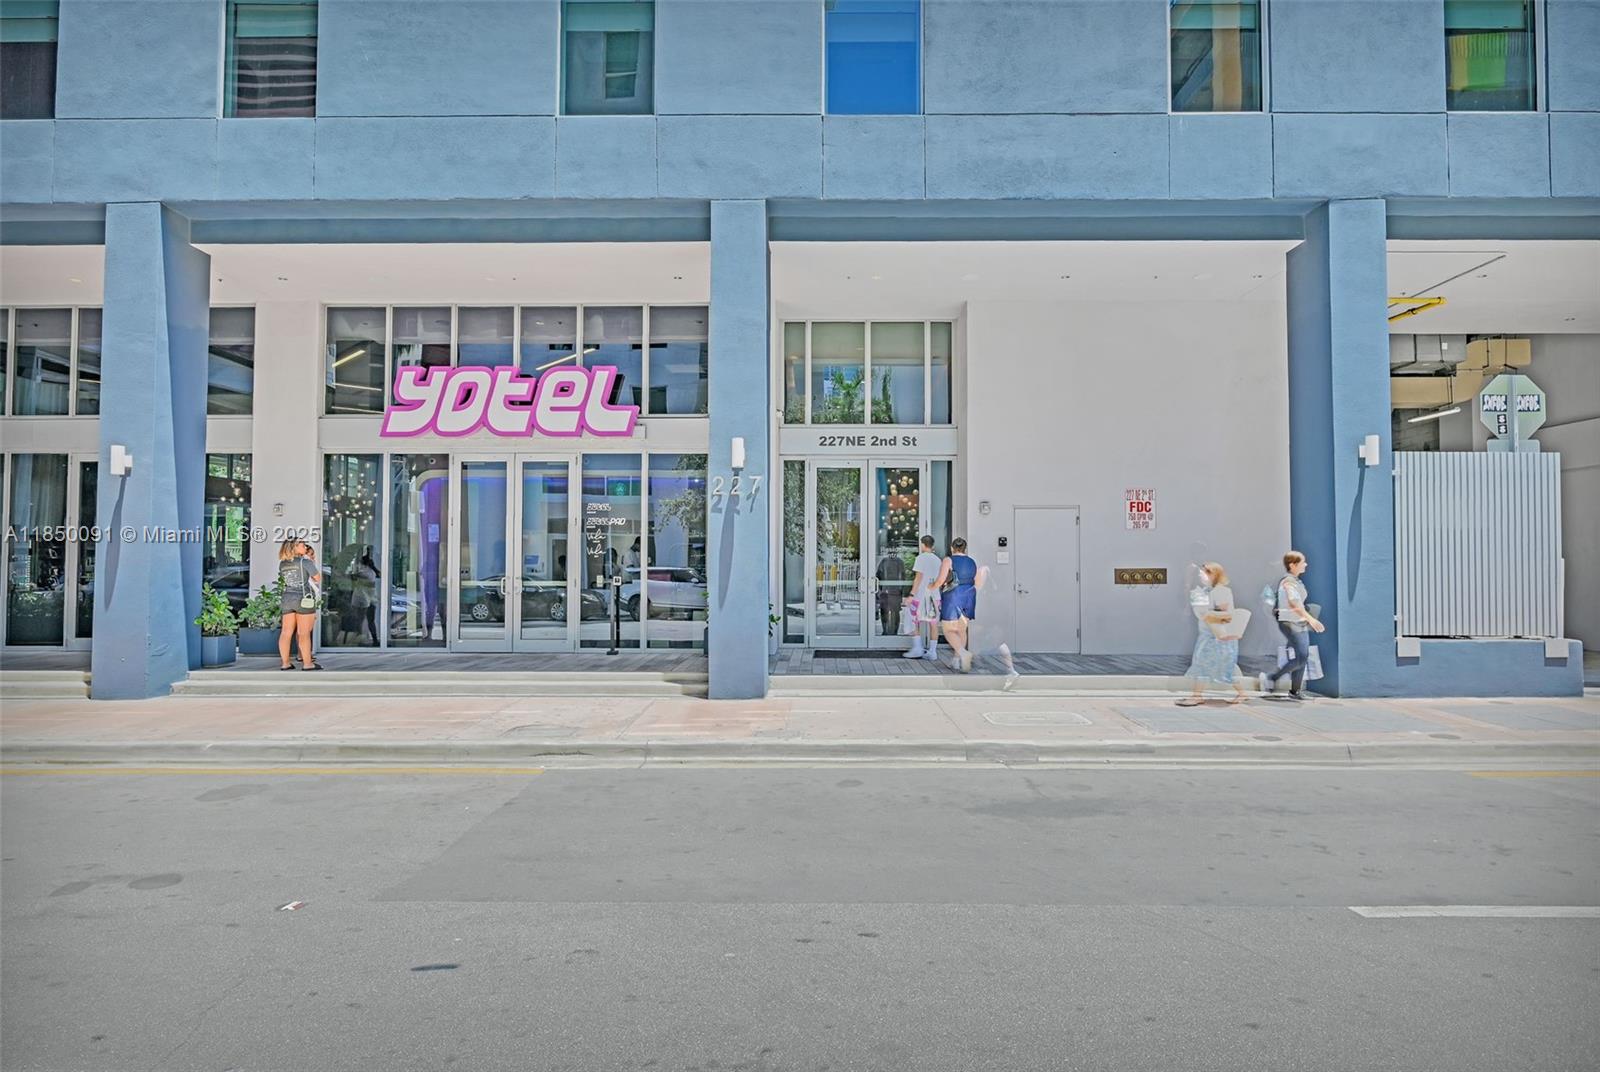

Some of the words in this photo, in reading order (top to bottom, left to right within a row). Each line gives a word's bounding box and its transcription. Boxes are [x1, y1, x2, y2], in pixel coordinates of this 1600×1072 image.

[870, 435, 897, 447] 2nd
[902, 435, 918, 447] St
[713, 475, 762, 495] 227
[1129, 501, 1152, 512] FDC
